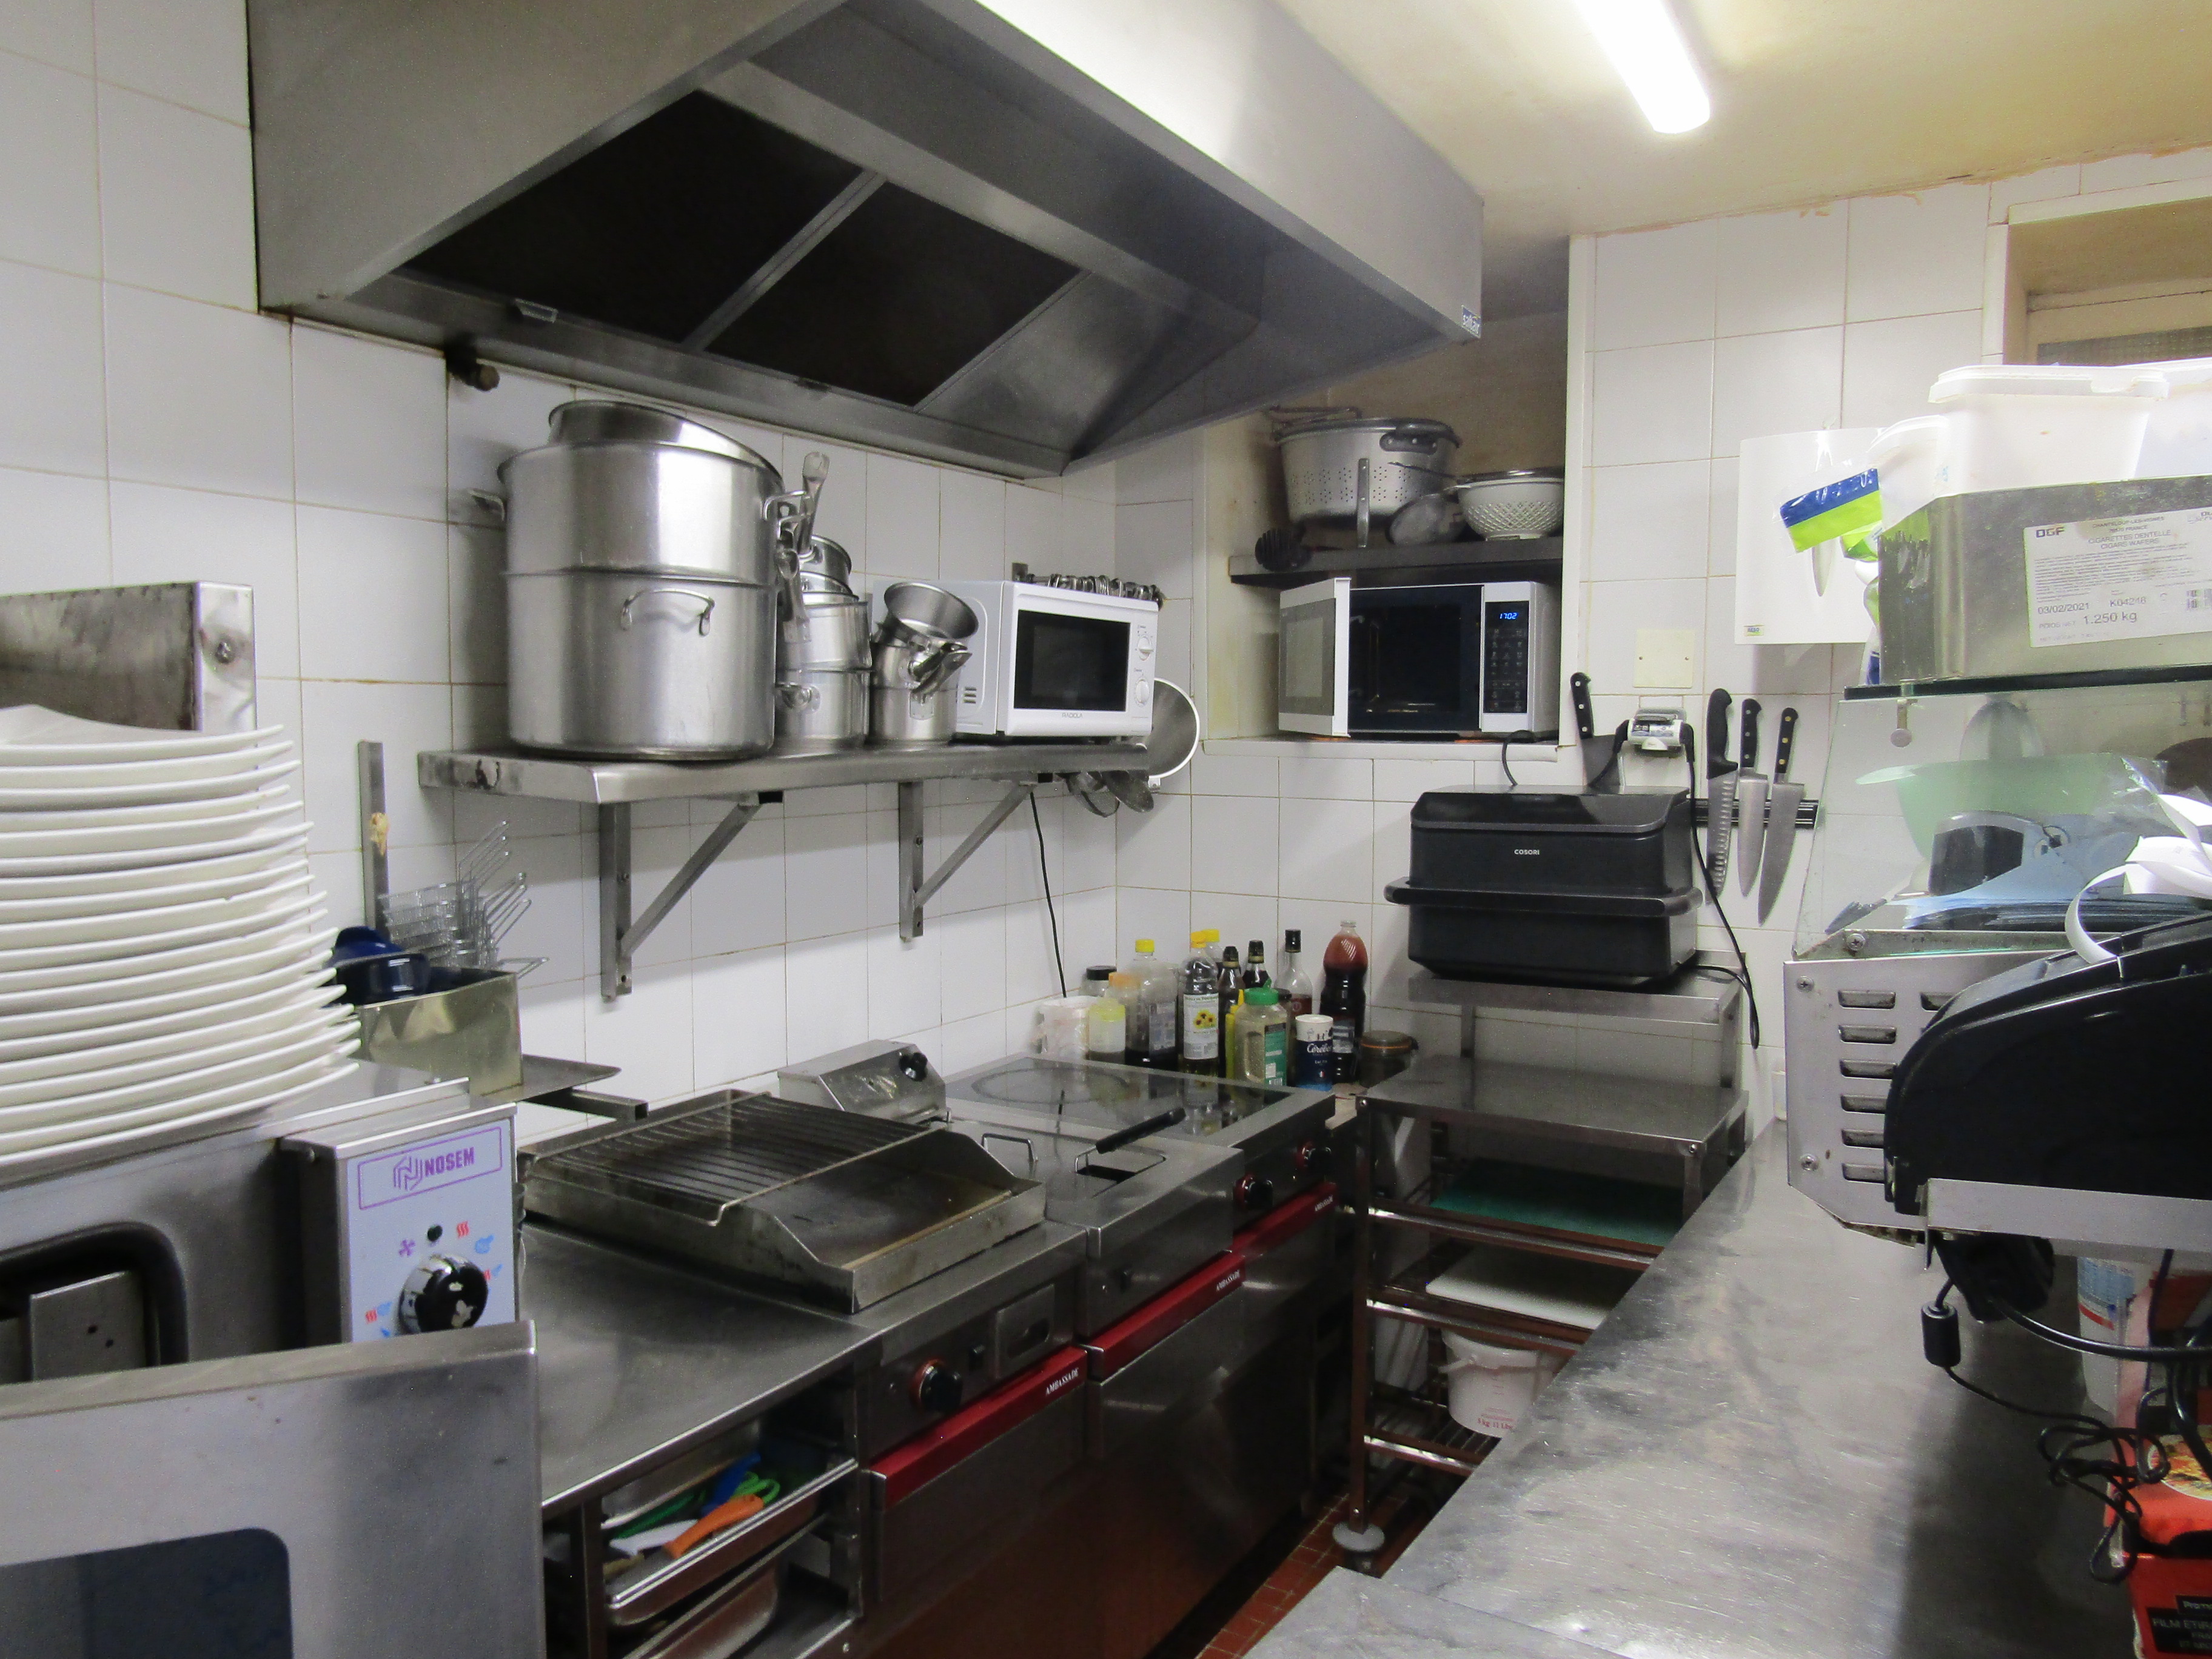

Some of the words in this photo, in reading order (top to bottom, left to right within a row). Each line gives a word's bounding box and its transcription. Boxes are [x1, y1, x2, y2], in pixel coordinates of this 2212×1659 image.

[2088, 532, 2133, 545] CIGARETTES
[2134, 530, 2171, 539] DENTELLE
[2100, 540, 2128, 550] CIGARS
[2129, 538, 2160, 546] WAFERS
[2037, 602, 2090, 614] 03/02/2021
[2083, 612, 2118, 625] 1.250
[2122, 611, 2137, 623] kg
[425, 1146, 475, 1177] NOSEM
[1046, 1367, 1079, 1396] AMBASSADE
